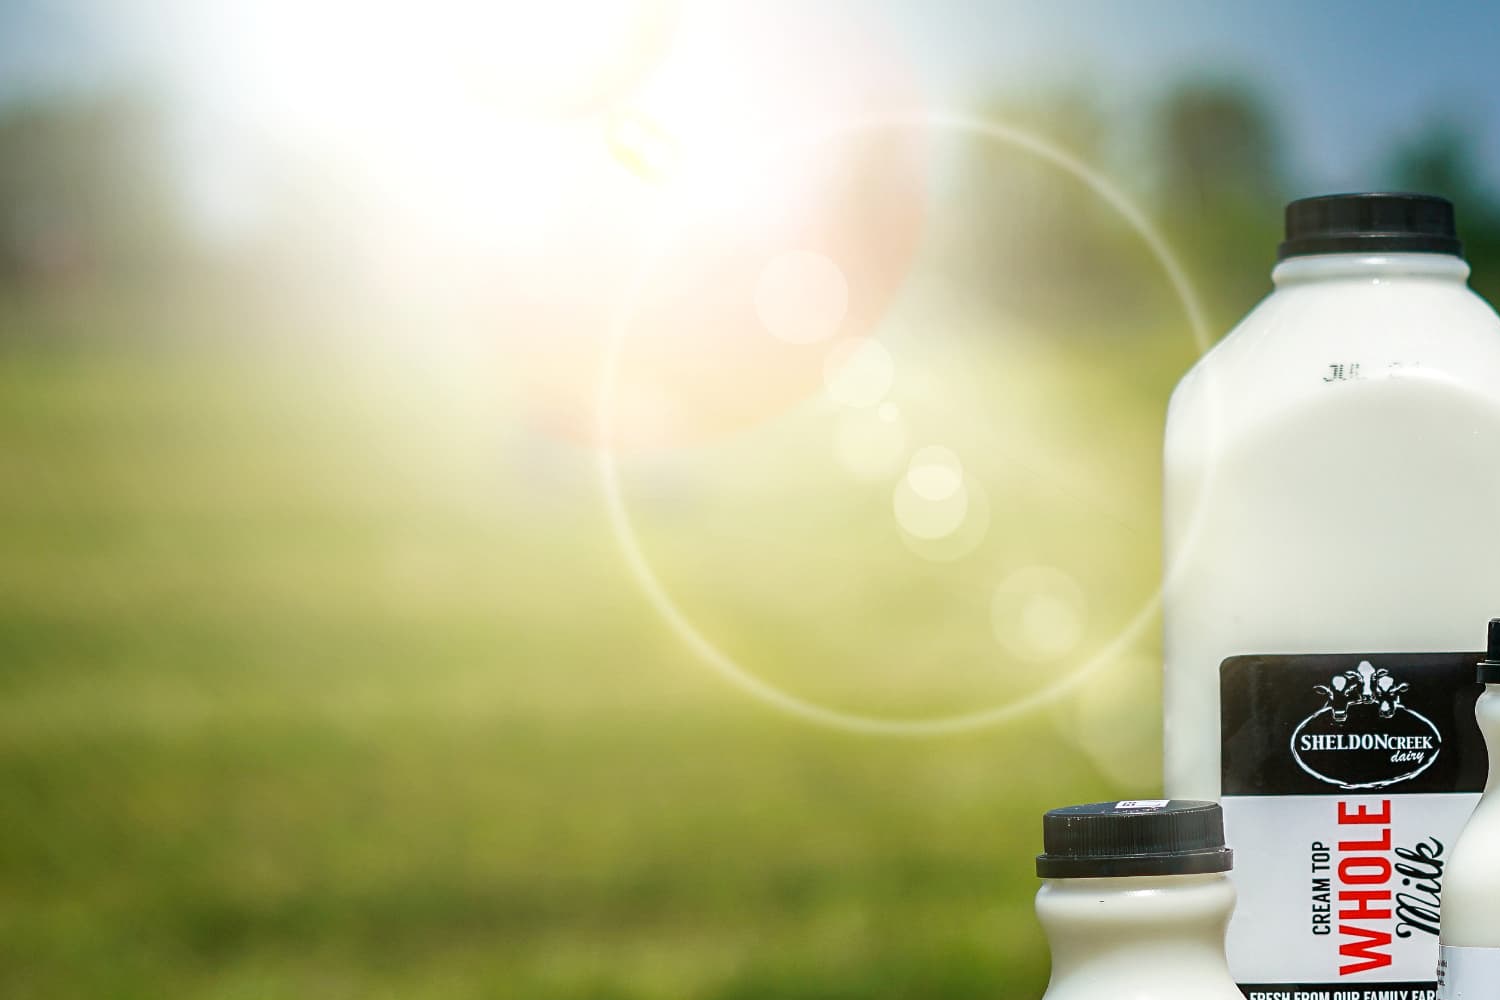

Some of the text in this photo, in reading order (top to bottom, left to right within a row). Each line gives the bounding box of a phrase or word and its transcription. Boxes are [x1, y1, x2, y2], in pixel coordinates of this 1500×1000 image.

[1390, 750, 1425, 764] dairy
[1311, 841, 1332, 936] CREAM TOP
[1337, 800, 1393, 977] WHOLE
[1394, 835, 1445, 939] Milk
